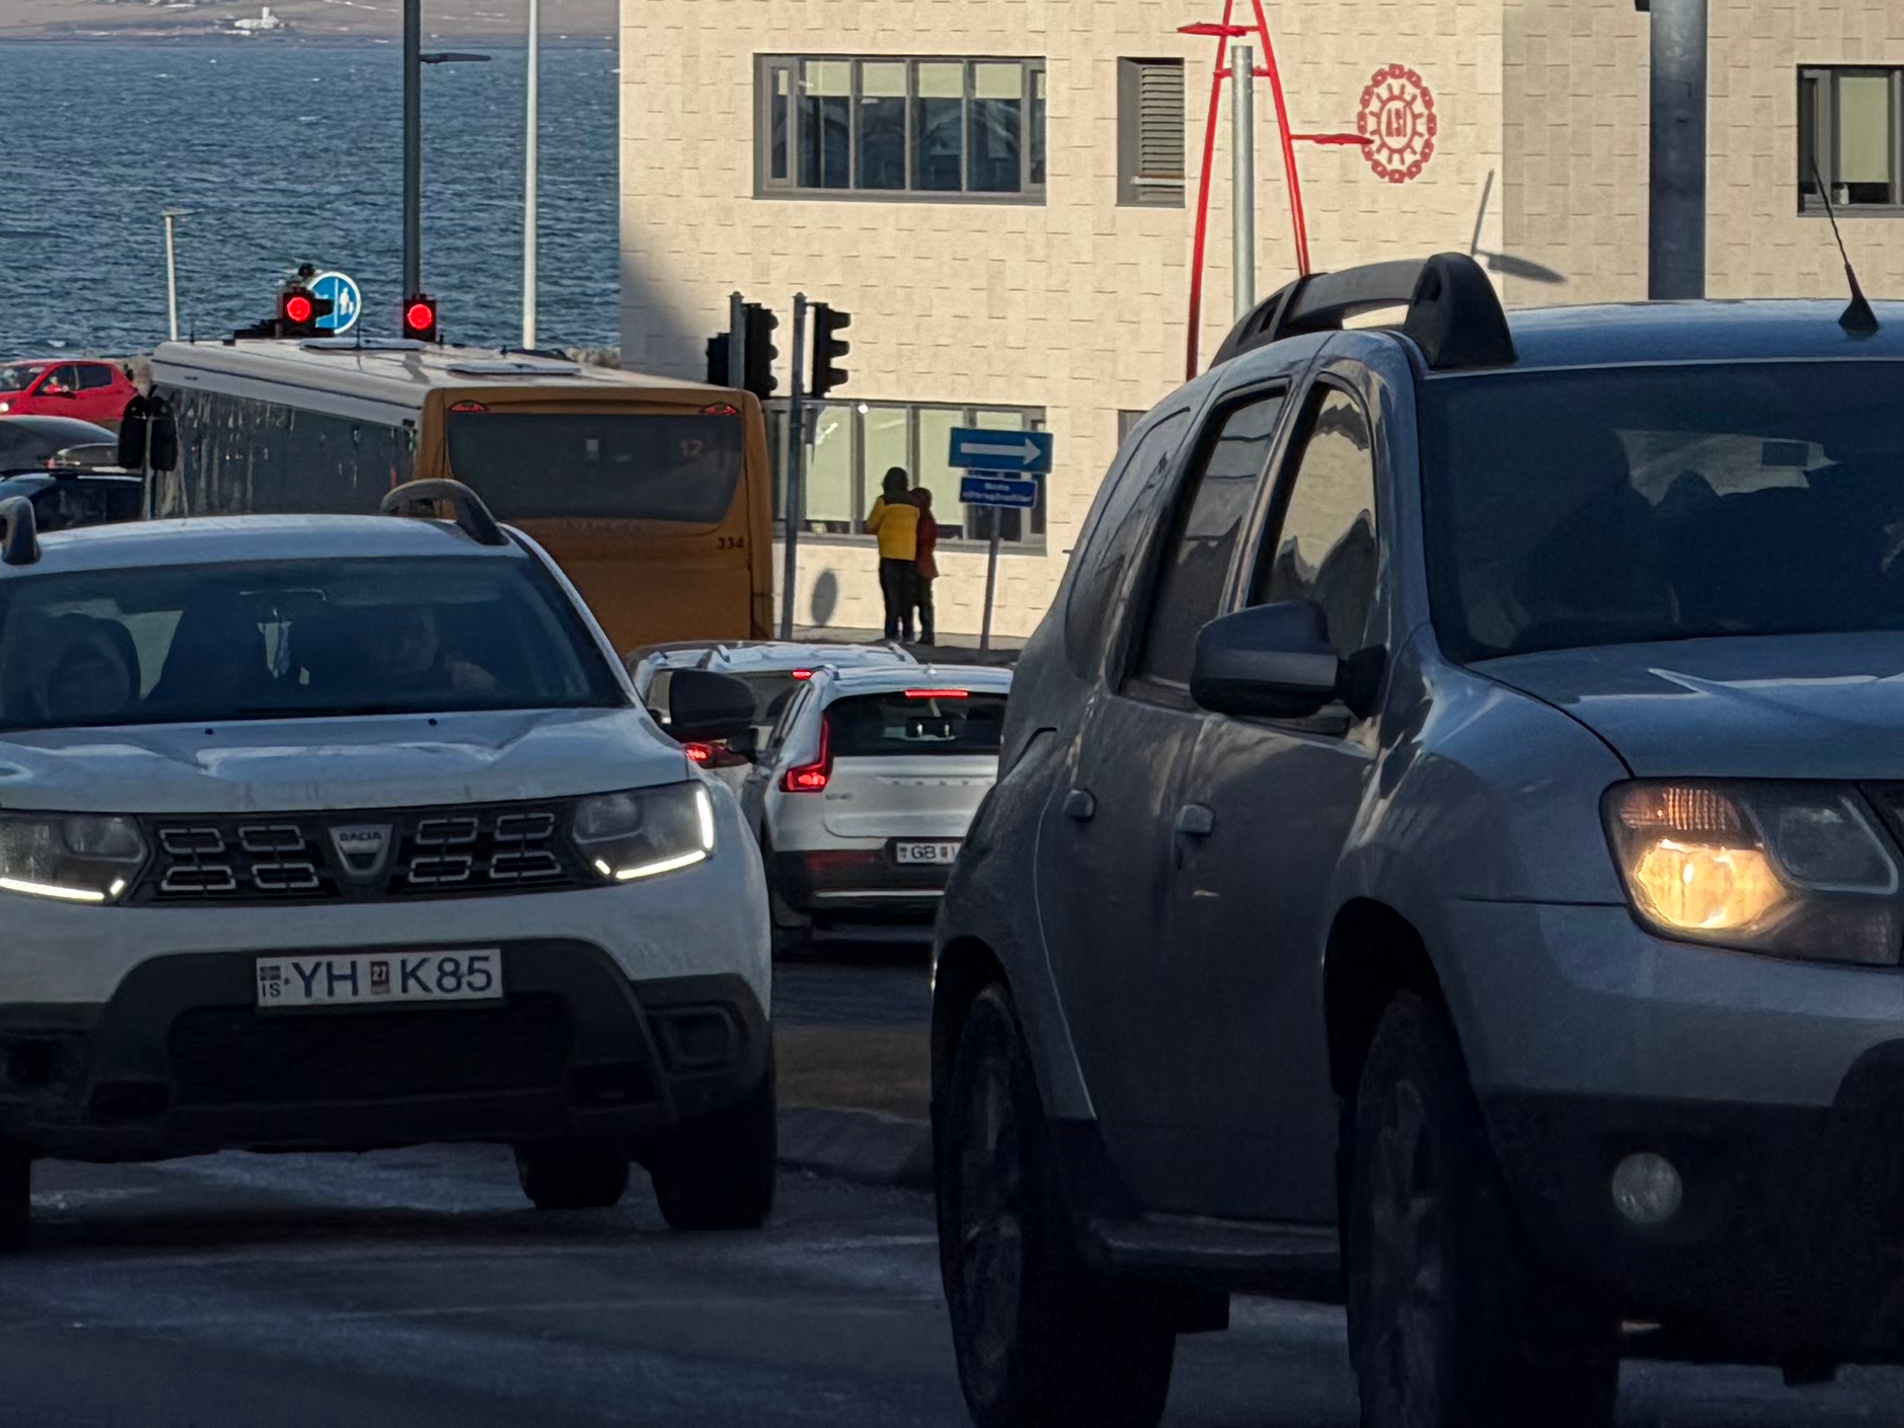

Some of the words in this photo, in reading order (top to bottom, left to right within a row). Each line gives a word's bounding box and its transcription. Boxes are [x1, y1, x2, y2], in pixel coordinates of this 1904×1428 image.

[681, 439, 703, 457] 12
[911, 845, 936, 860] GB
[291, 960, 359, 998] YH
[400, 955, 493, 994] K85
[372, 966, 388, 981] 27
[260, 983, 282, 998] IS
